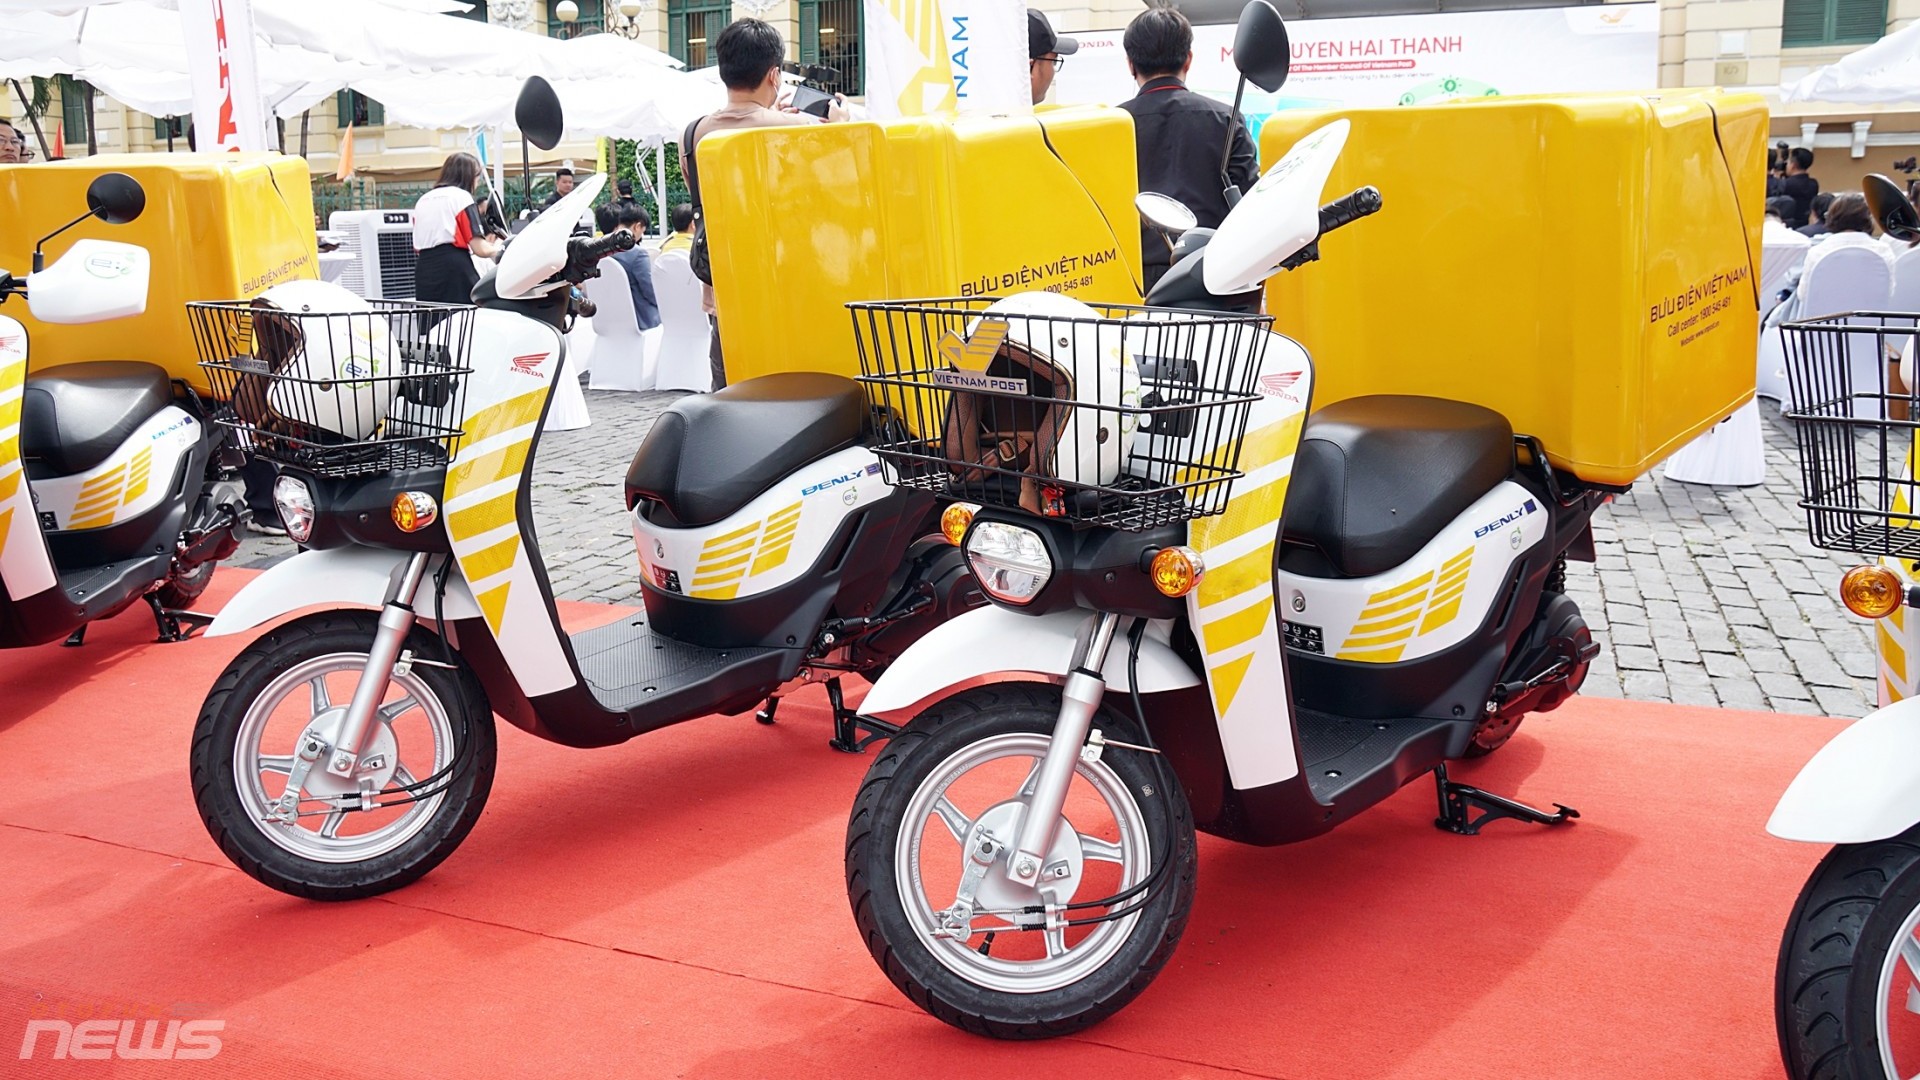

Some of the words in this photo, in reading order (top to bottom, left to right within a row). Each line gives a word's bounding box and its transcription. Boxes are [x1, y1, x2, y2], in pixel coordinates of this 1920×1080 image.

[1077, 40, 1115, 49] ONDA
[1290, 41, 1343, 59] UYEN
[1349, 39, 1383, 57] HAI
[1390, 36, 1462, 55] THANH
[952, 16, 969, 98] NAM
[243, 277, 260, 294] BƯU
[293, 255, 308, 269] NAM
[961, 275, 998, 297] BƯU
[1002, 265, 1043, 288] ĐIỆN
[1045, 255, 1079, 278] VIỆT
[1083, 248, 1117, 268] NAM
[1063, 279, 1078, 291] 545
[1080, 275, 1093, 287] 481
[1650, 297, 1675, 323] BƯU
[1676, 284, 1702, 311] ĐIỆN
[1703, 273, 1724, 299] VIỆT
[1725, 265, 1748, 288] NAM
[1667, 322, 1680, 337] Call
[510, 366, 545, 379] HONDA
[934, 374, 987, 388] VIETNAM
[990, 380, 1025, 391] POST
[1258, 387, 1300, 403] HONDA
[801, 469, 864, 497] BENLY
[1474, 507, 1524, 539] BENLY
